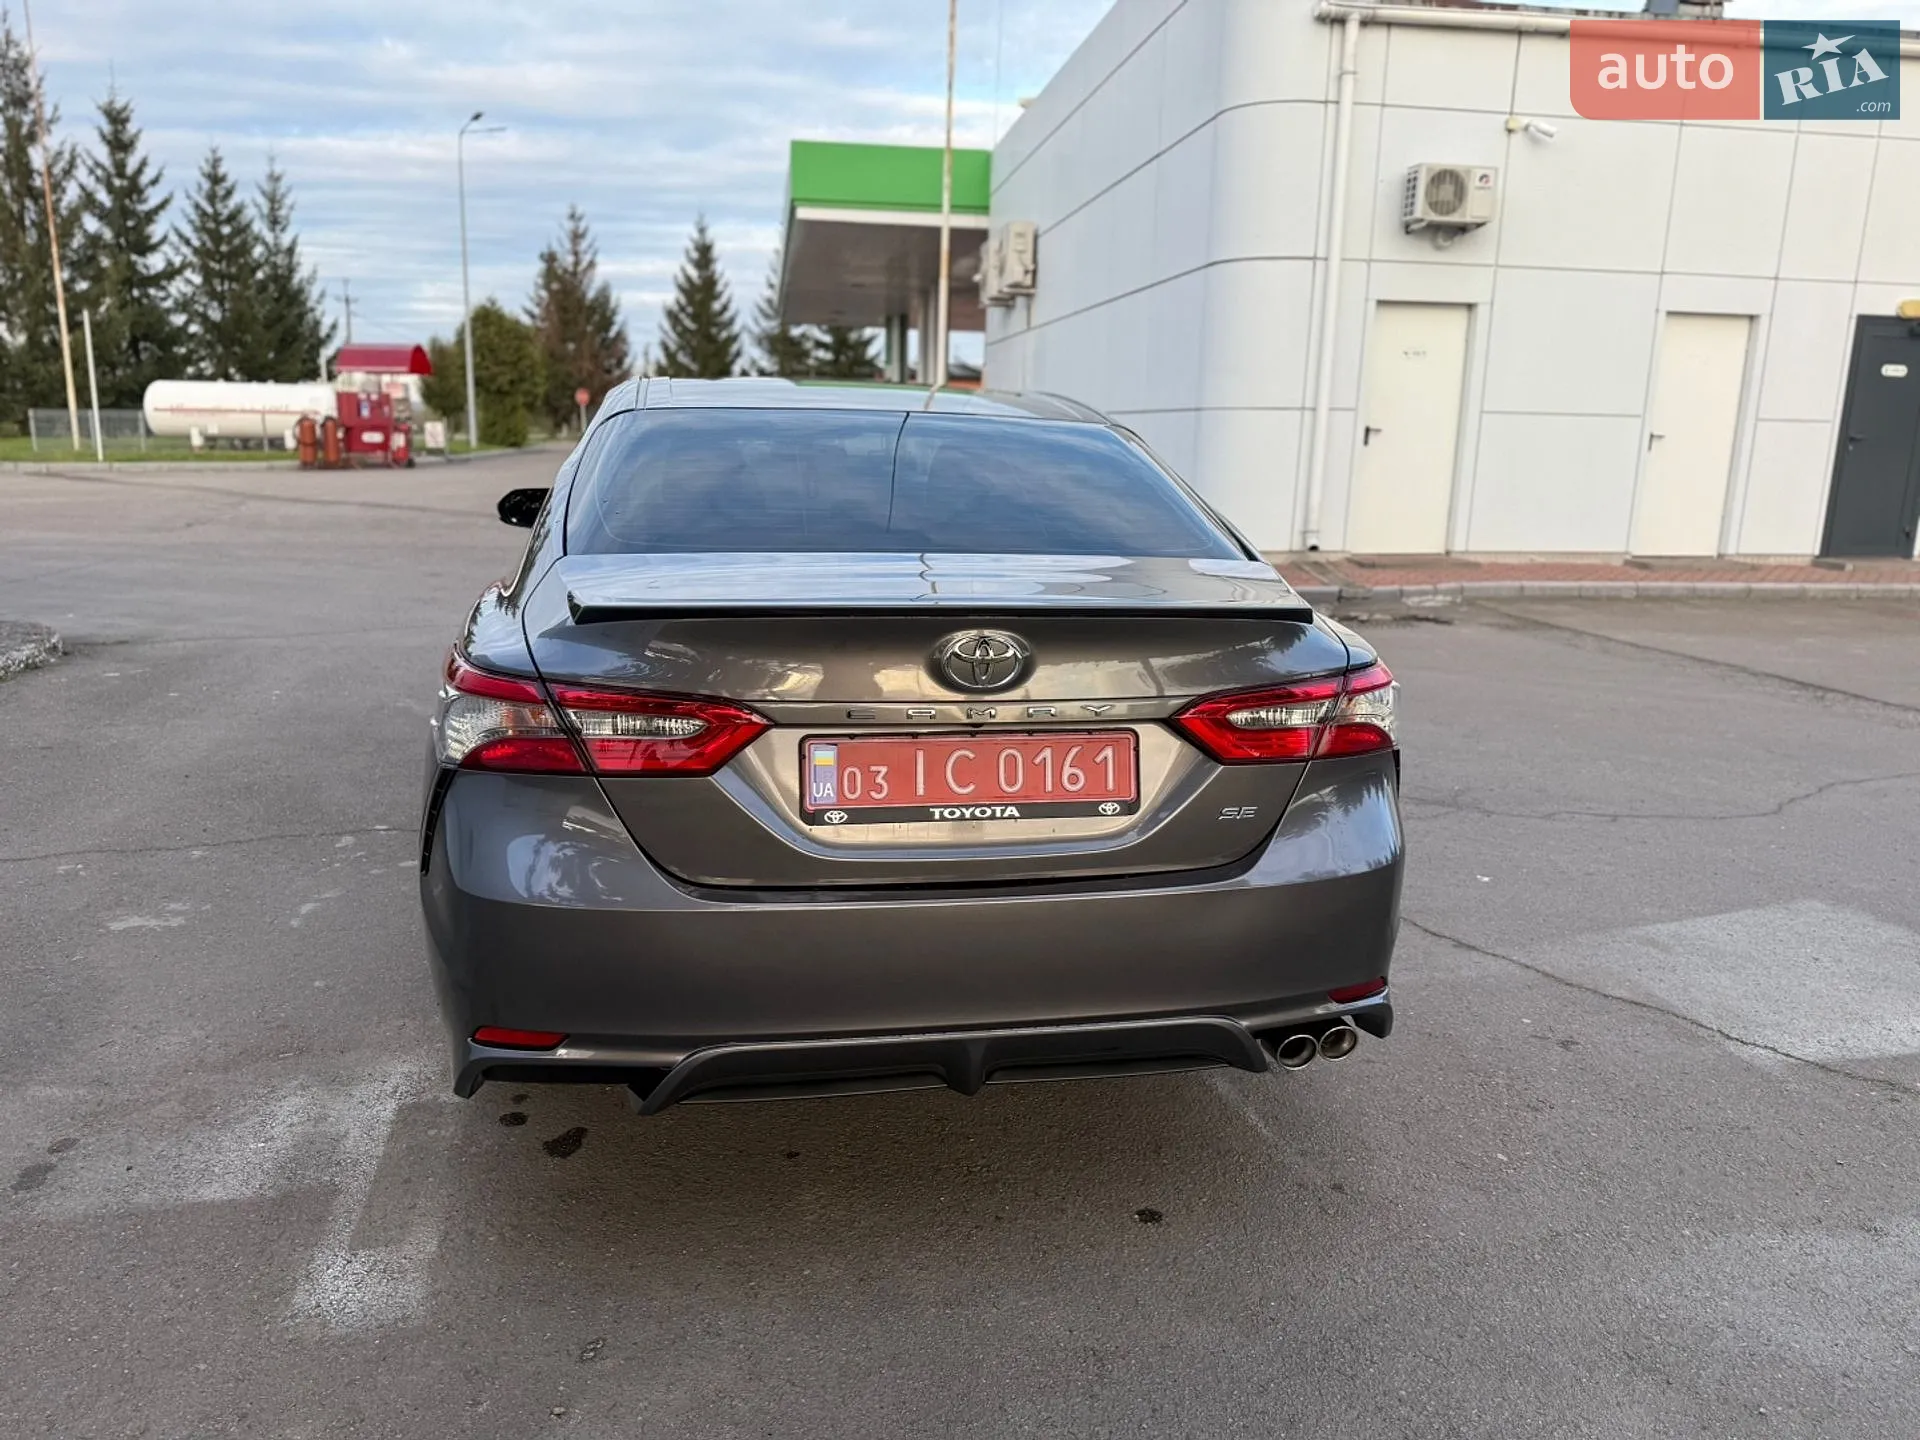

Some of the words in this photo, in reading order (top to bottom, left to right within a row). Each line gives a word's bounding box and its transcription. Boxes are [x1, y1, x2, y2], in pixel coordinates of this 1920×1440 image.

[846, 704, 1114, 720] CAMRY
[812, 782, 834, 798] UA
[842, 765, 889, 800] 03
[998, 745, 1115, 793] 0161
[929, 806, 1021, 821] TOYOTA
[1217, 806, 1258, 820] SE
